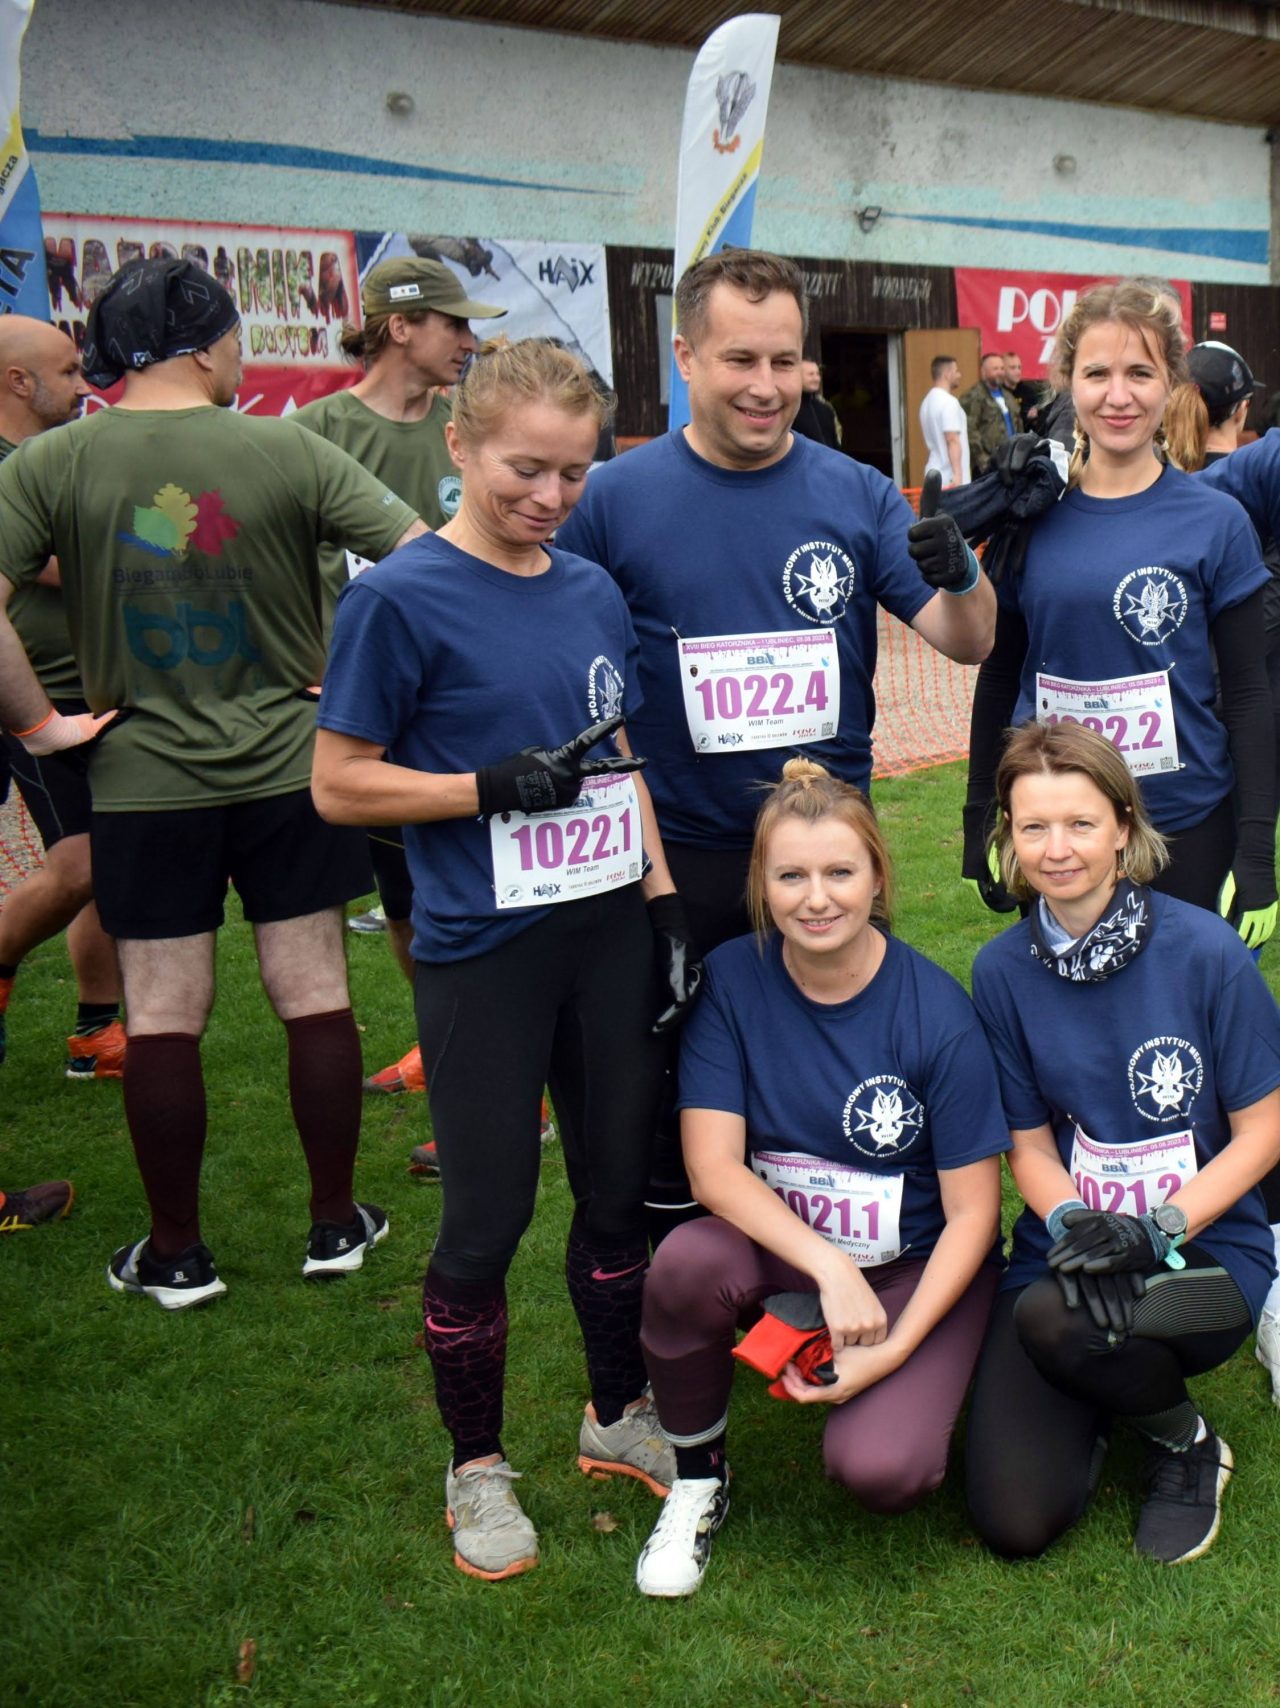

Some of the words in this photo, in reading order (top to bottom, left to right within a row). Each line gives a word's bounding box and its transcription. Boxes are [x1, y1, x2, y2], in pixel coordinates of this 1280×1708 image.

[783, 548, 801, 604] WOJSKOWY
[800, 541, 843, 556] INSTYTUT
[1113, 571, 1136, 620] WOJSKOWY
[1137, 566, 1179, 583] INSTYTUT
[695, 670, 828, 721] 1022.4
[748, 719, 764, 727] WIM
[510, 808, 631, 871] 1022.1
[566, 866, 581, 876] WIM
[583, 864, 600, 873] Team
[1144, 1036, 1191, 1050] INSTYTUT
[1188, 1045, 1204, 1094] MEDYCZNY
[842, 1082, 865, 1137] WOJSKOWY
[774, 1186, 879, 1241] 021.1
[837, 1237, 870, 1250] Medyczny
